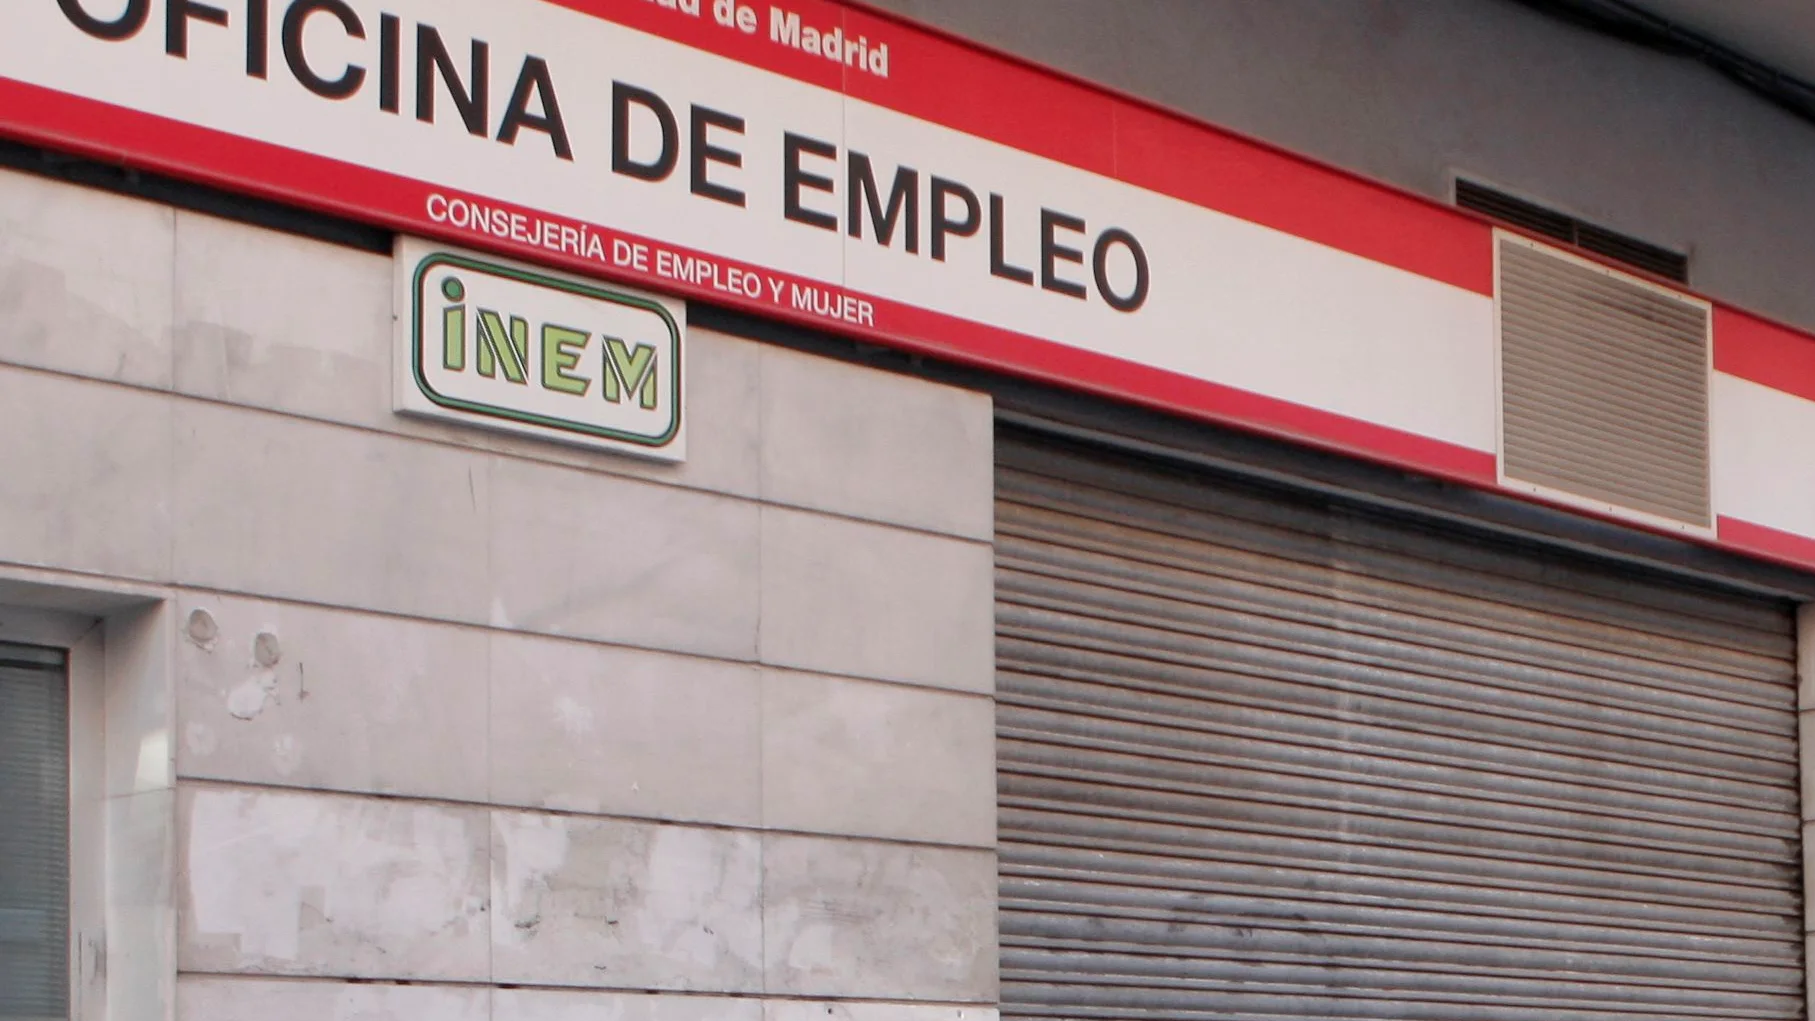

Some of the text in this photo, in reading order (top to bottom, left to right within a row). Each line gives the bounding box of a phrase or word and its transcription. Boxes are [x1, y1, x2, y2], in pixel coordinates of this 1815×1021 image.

[713, 0, 889, 78] de Madrid
[426, 193, 875, 327] CONSEJERÍA DE EMPLEO Y MUJER
[611, 80, 747, 208] DE
[784, 130, 1150, 313] EMPLEO
